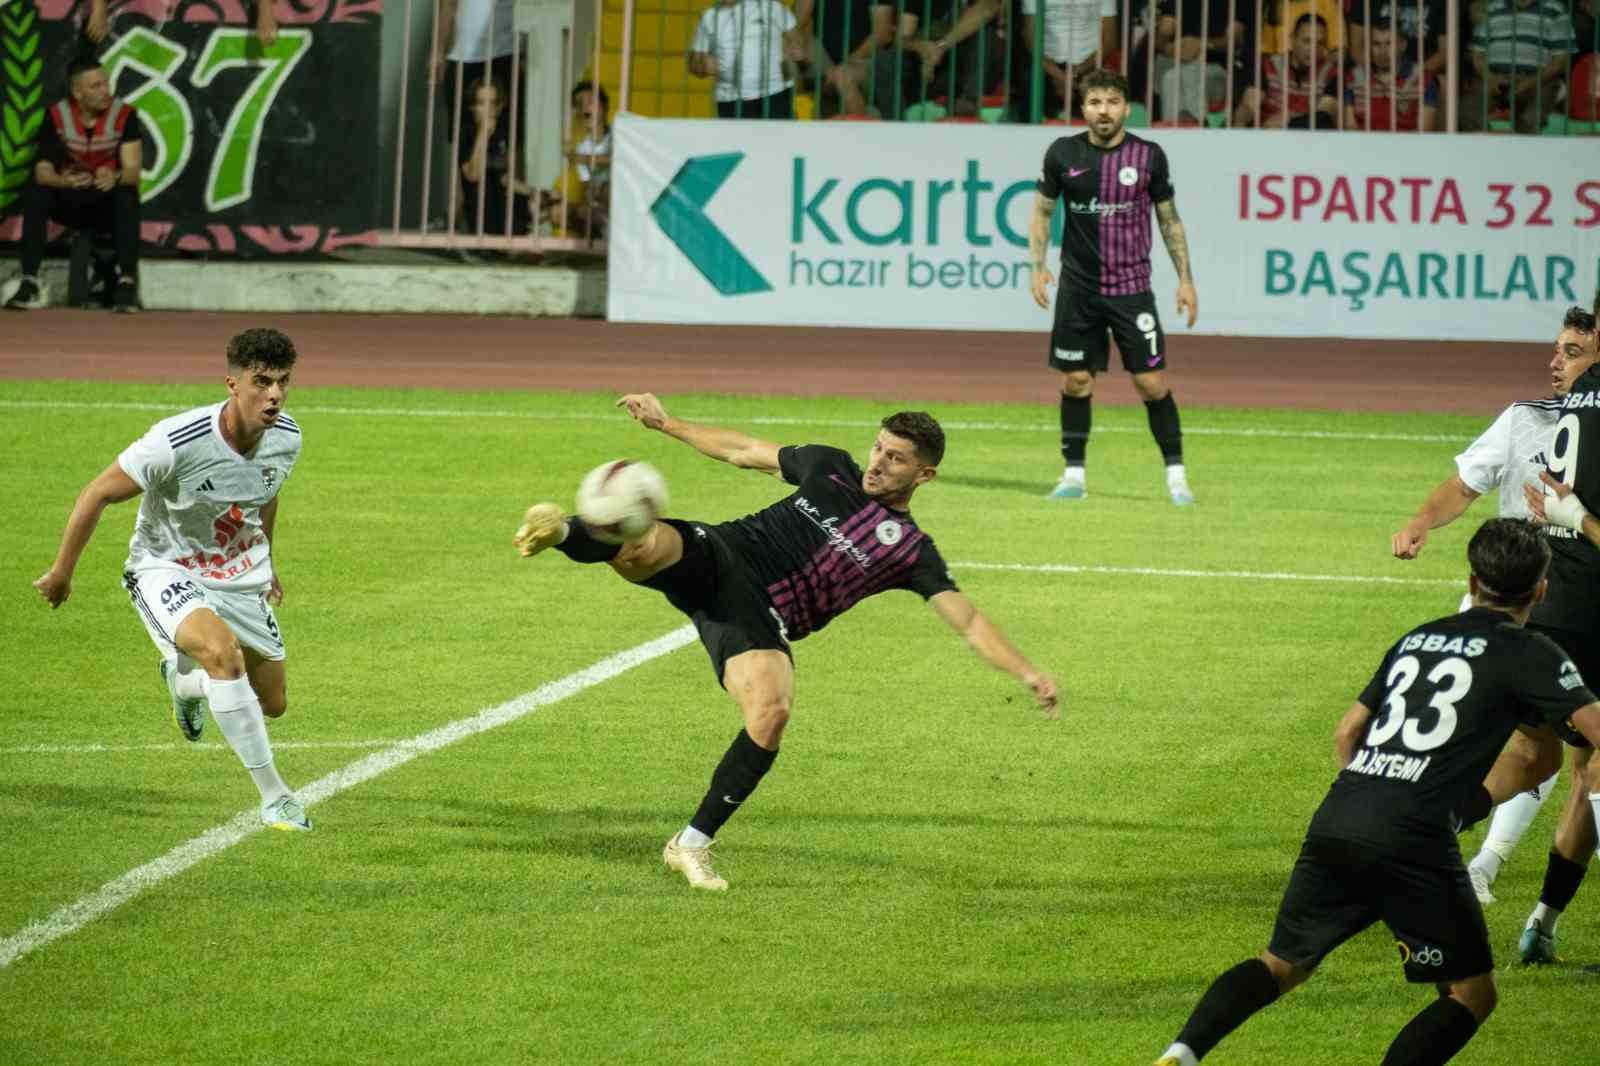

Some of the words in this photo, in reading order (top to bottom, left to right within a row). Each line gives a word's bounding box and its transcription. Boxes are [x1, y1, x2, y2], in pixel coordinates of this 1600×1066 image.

[1238, 174, 1468, 225] ISPARTA
[1486, 183, 1553, 229] 32
[789, 251, 891, 288] hazır
[1264, 248, 1577, 311] BAŞARILAR
[1547, 413, 1580, 493] 9
[1365, 655, 1473, 752] 33
